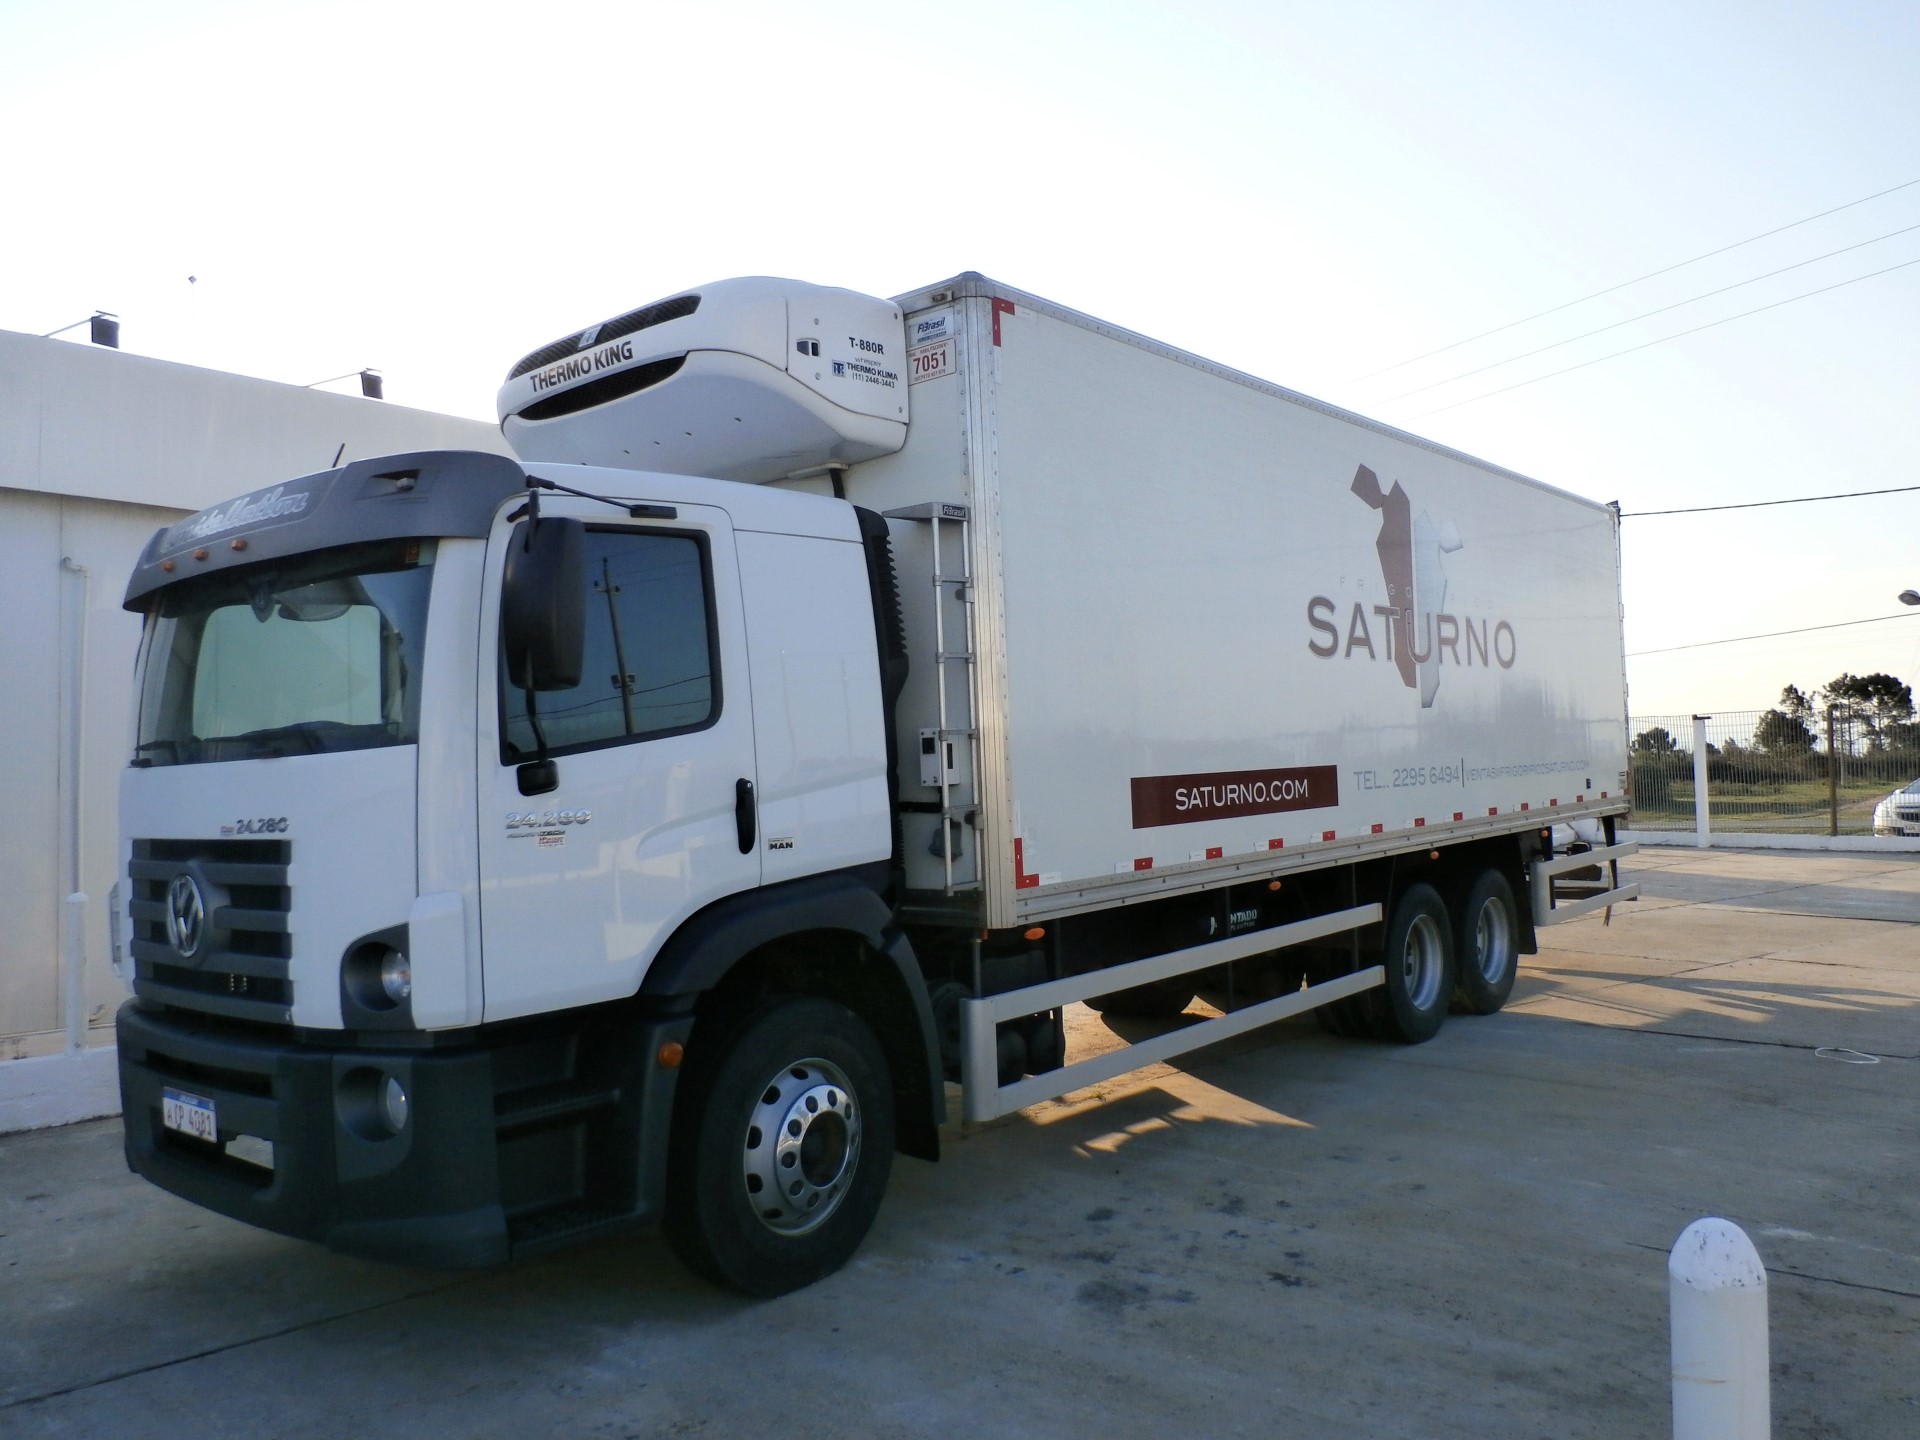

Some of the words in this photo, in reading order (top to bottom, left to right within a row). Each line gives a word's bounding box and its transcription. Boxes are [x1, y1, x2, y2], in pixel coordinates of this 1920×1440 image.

[848, 336, 884, 355] T-880R
[530, 354, 593, 393] THERMO
[595, 340, 634, 371] KING
[846, 362, 877, 376] THERMO
[877, 369, 899, 381] KLIMA
[913, 349, 947, 375] 7051
[852, 372, 864, 382] (11)
[1307, 595, 1516, 669] SATURNO
[1392, 765, 1427, 788] 2295
[1429, 763, 1460, 786] 6494
[1174, 778, 1309, 811] SATURNO.COM
[506, 808, 593, 829] 24.280
[769, 841, 793, 850] MAN
